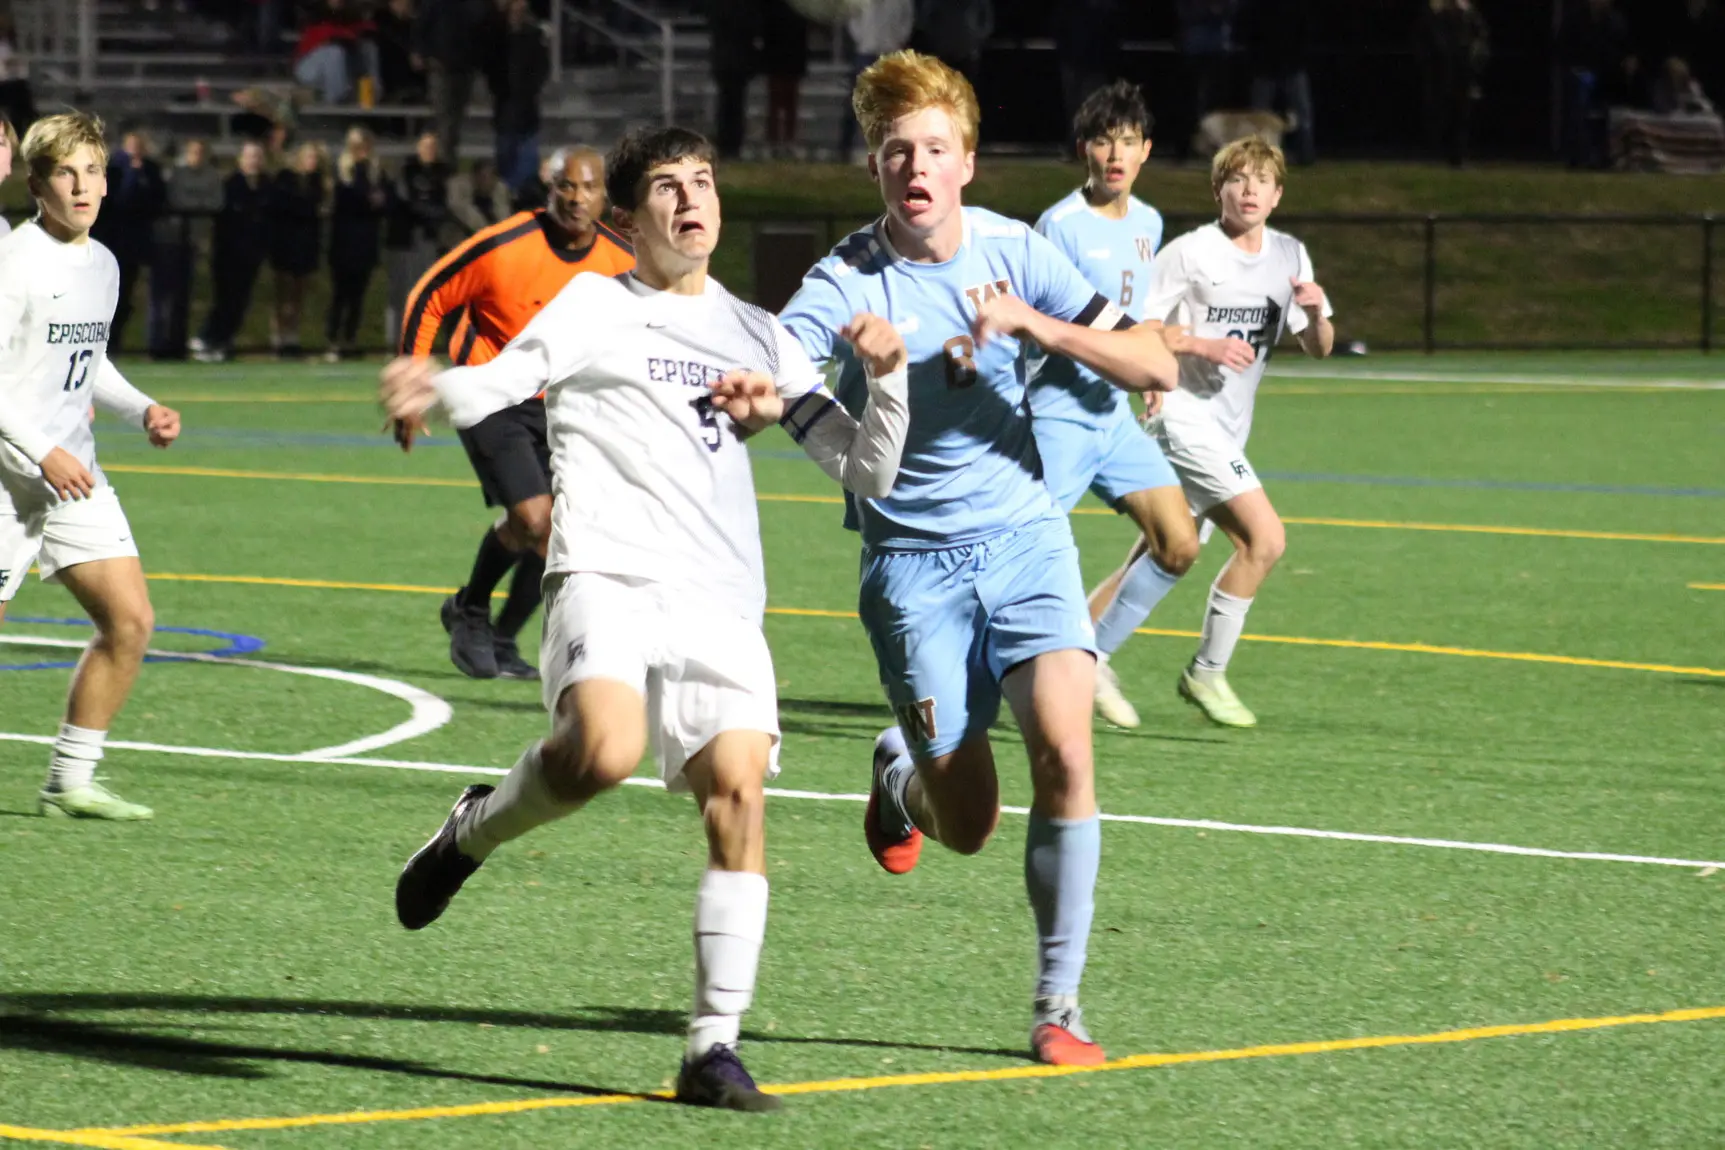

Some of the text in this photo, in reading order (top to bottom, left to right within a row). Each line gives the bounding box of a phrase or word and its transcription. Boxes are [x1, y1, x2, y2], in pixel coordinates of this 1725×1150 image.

[1134, 237, 1152, 263] W
[1119, 269, 1135, 308] 6
[1206, 306, 1281, 325] EPISCOP
[1227, 330, 1265, 357] 5
[63, 349, 94, 392] 13
[698, 395, 724, 454] 5
[898, 695, 938, 742] W
